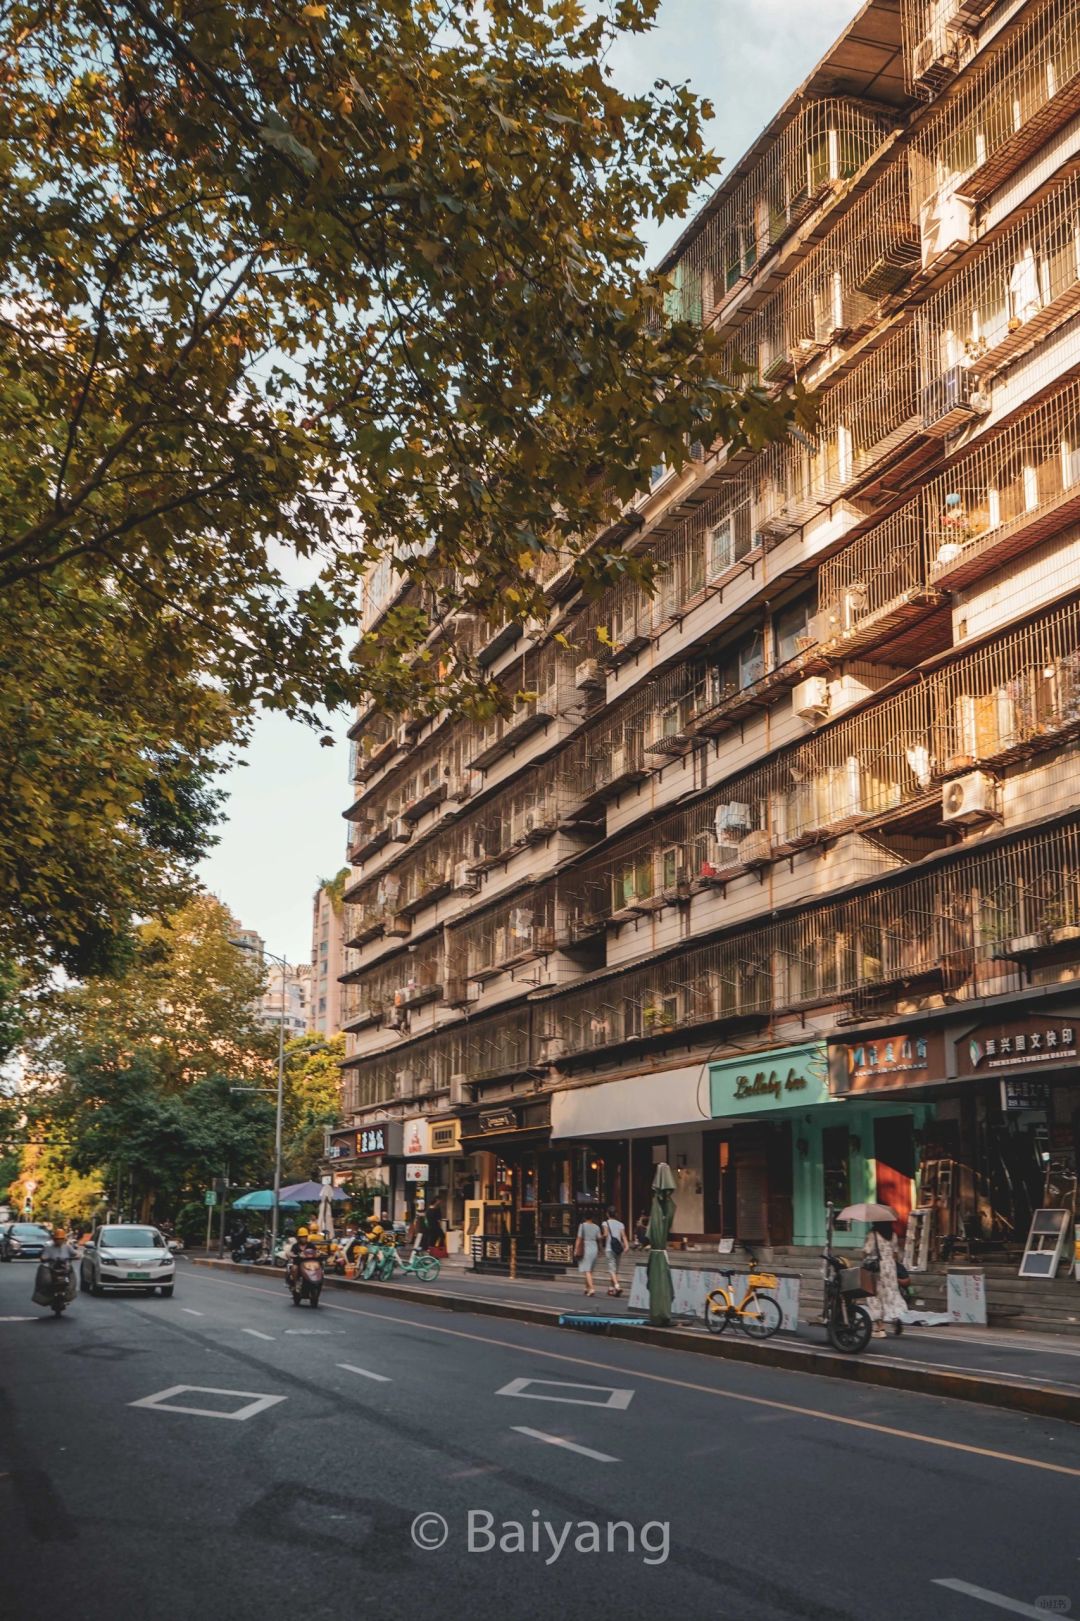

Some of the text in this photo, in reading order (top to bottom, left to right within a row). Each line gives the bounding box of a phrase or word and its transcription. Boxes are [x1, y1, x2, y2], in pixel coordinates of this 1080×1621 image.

[985, 1028, 1073, 1055] 振兴图文快印
[733, 1070, 782, 1099] Lullaby
